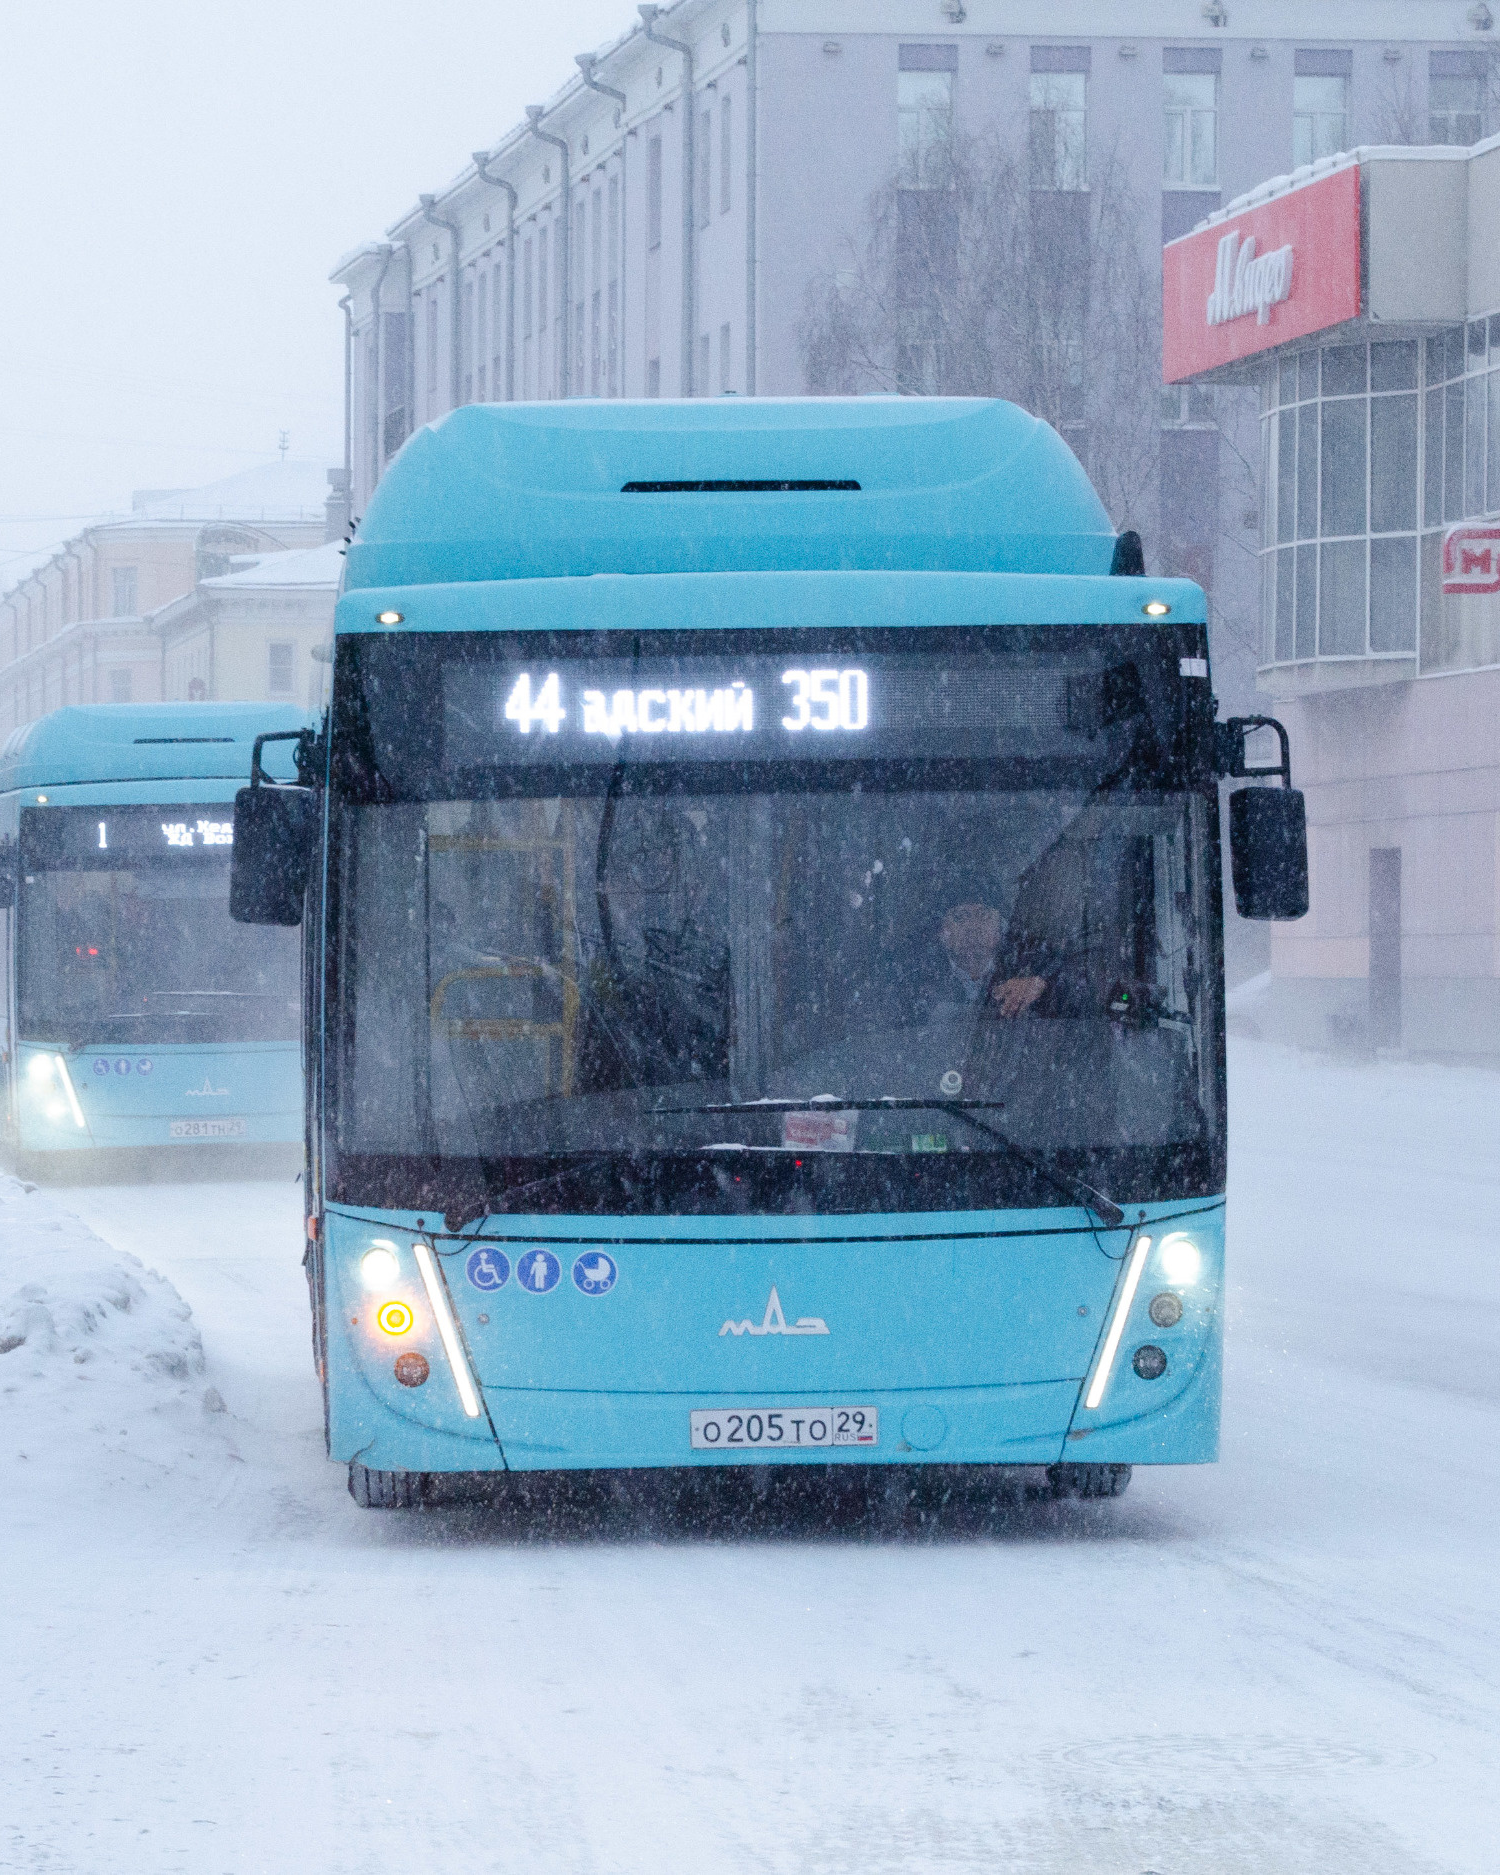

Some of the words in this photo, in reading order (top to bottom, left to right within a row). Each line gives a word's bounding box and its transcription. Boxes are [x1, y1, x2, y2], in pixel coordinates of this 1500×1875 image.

[505, 672, 565, 733] 44
[781, 669, 868, 731] 350
[98, 822, 108, 849] 1
[837, 1411, 866, 1433] 29
